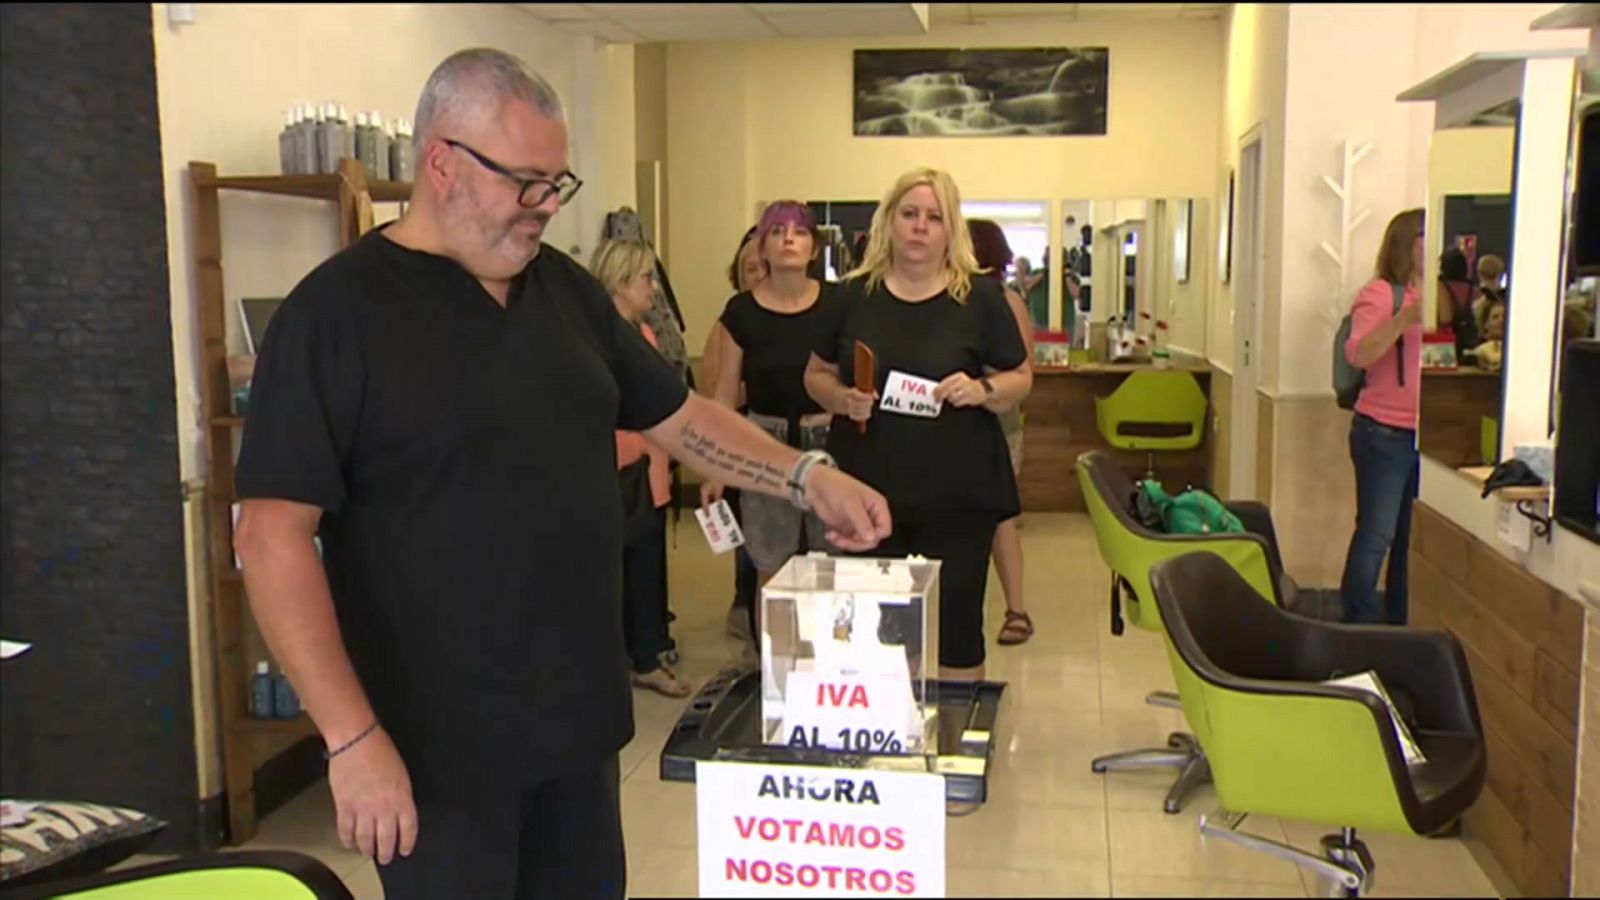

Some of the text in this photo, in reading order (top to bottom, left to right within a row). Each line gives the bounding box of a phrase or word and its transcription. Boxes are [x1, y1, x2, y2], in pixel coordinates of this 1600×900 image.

[901, 379, 927, 396] IVA
[884, 396, 937, 415] AL 10%
[816, 683, 869, 709] IVA
[787, 725, 902, 754] AL 10%
[757, 774, 881, 805] AHORA
[734, 815, 905, 851] VOTAMOS
[725, 858, 916, 895] NOSOTROS
